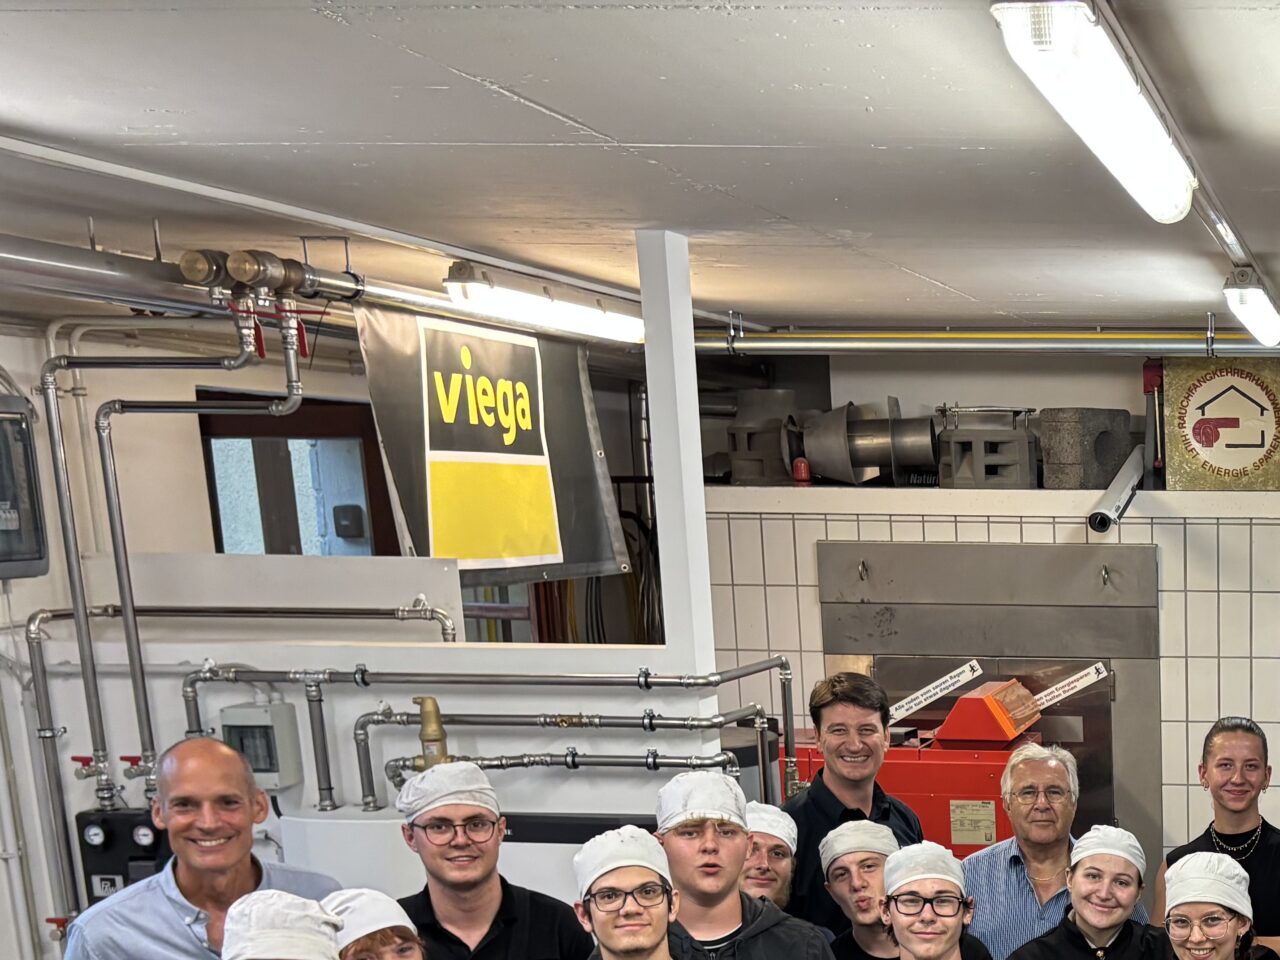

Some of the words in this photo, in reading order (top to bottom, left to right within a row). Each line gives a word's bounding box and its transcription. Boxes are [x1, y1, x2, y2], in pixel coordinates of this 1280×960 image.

[433, 345, 532, 445] viega
[1181, 433, 1200, 459] HILFT
[1201, 460, 1250, 478] ENERGIE
[909, 473, 939, 485] Natürl
